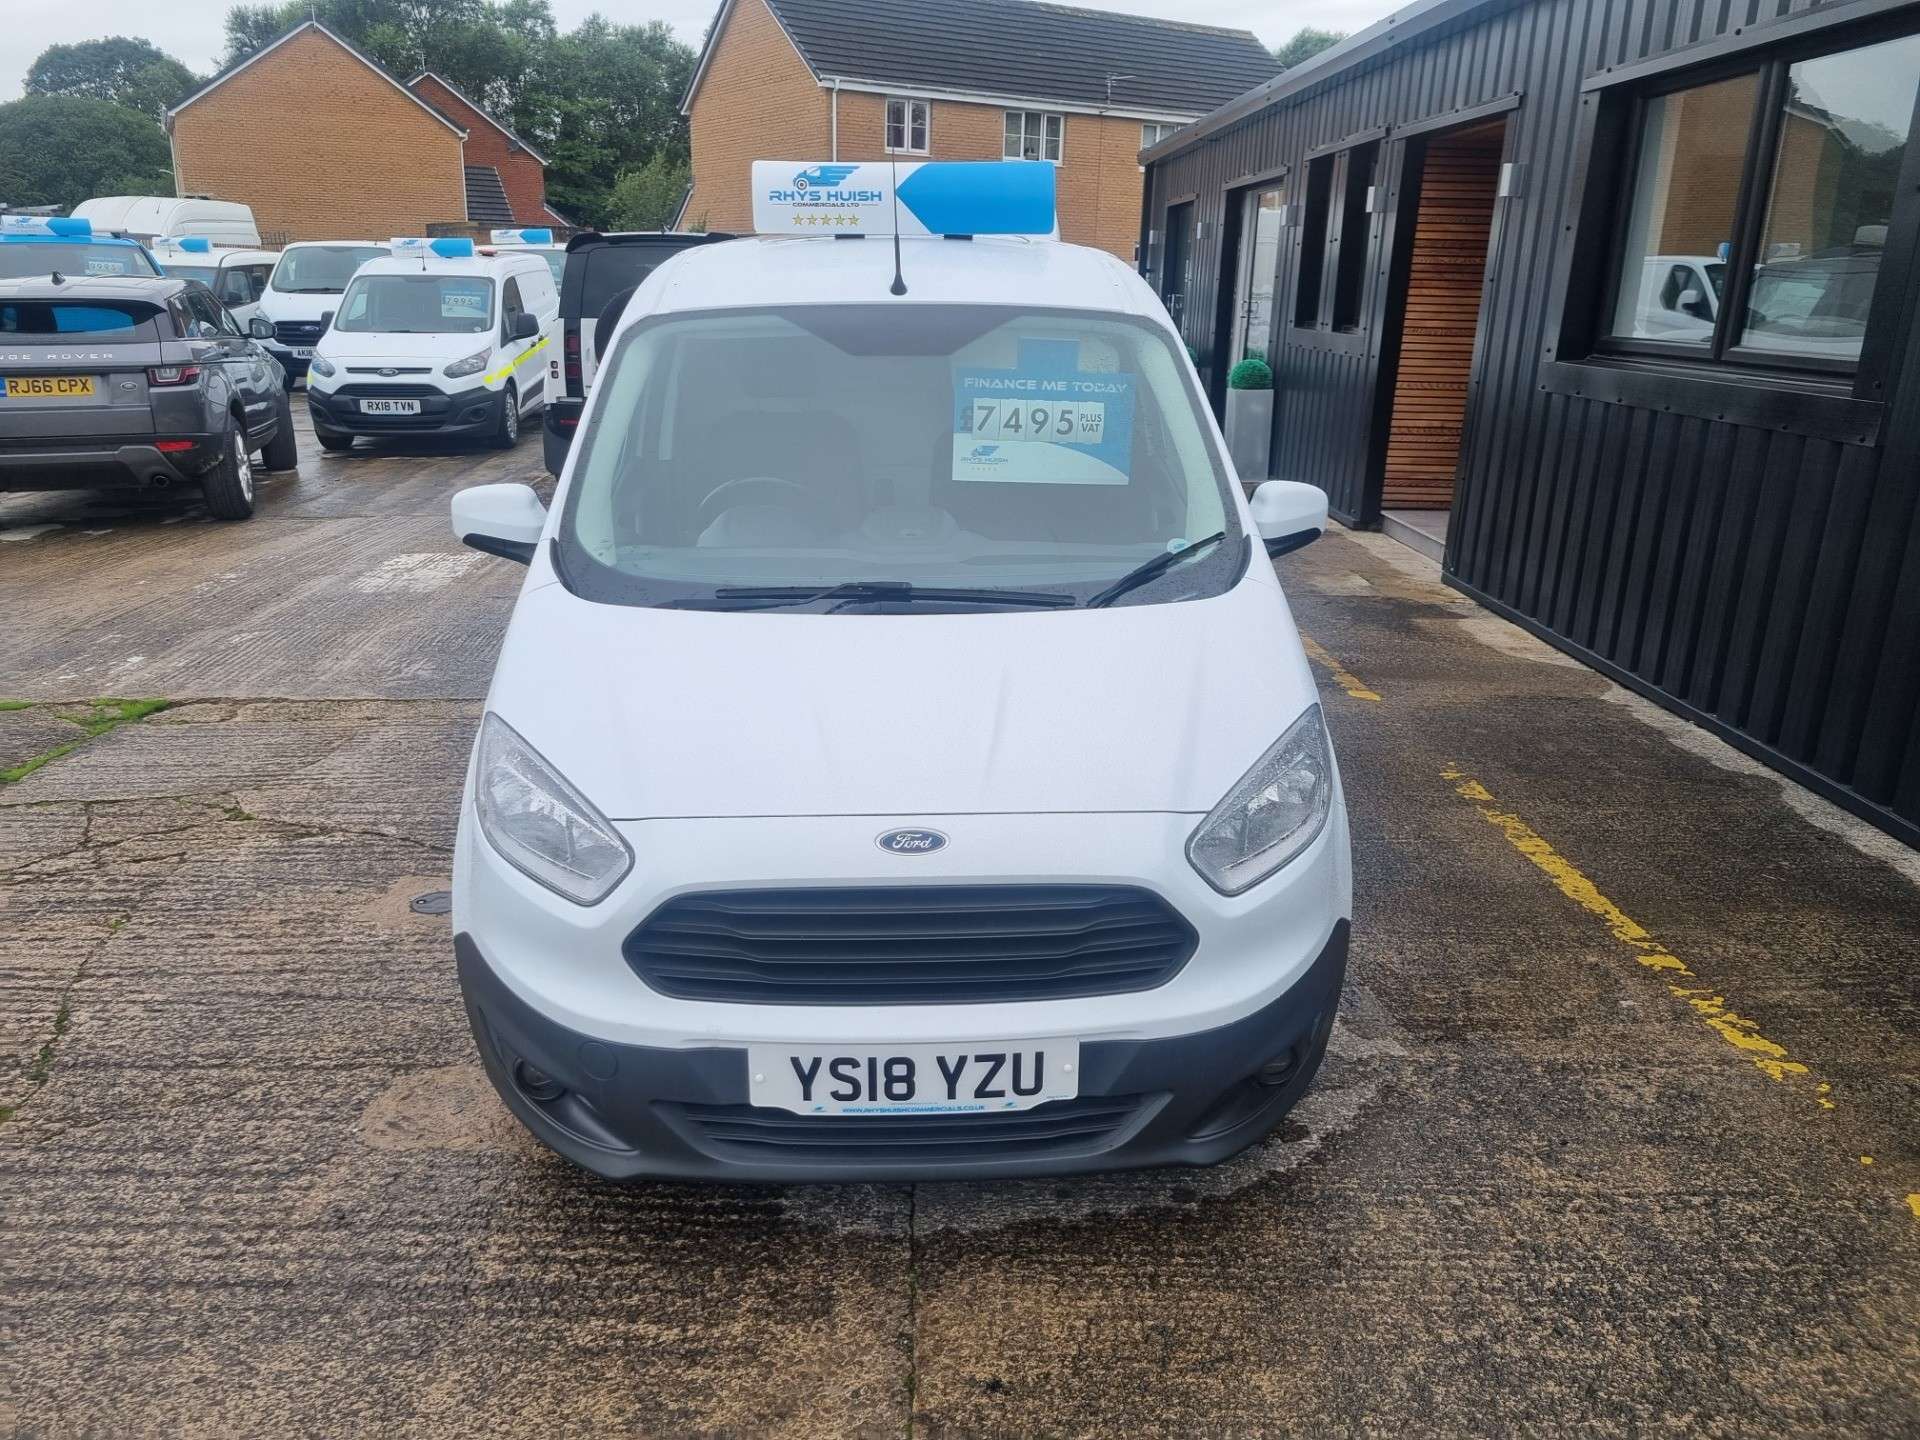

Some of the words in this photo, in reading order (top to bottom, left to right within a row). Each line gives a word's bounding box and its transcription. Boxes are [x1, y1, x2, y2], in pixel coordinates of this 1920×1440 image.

[768, 191, 822, 201] RHYS
[827, 191, 882, 201] HUISH
[8, 380, 53, 394] RJ66
[57, 379, 90, 393] CPX
[964, 377, 1037, 391] FINANCE
[1042, 381, 1067, 391] ME
[1072, 382, 1128, 393] TODAY
[367, 401, 391, 411] RX18
[393, 401, 414, 411] TVN
[1079, 413, 1103, 422] PLUS
[1081, 423, 1101, 433] VAT
[892, 833, 932, 849] Ford
[790, 1056, 915, 1101] YS18
[936, 1051, 1044, 1100] YZU
